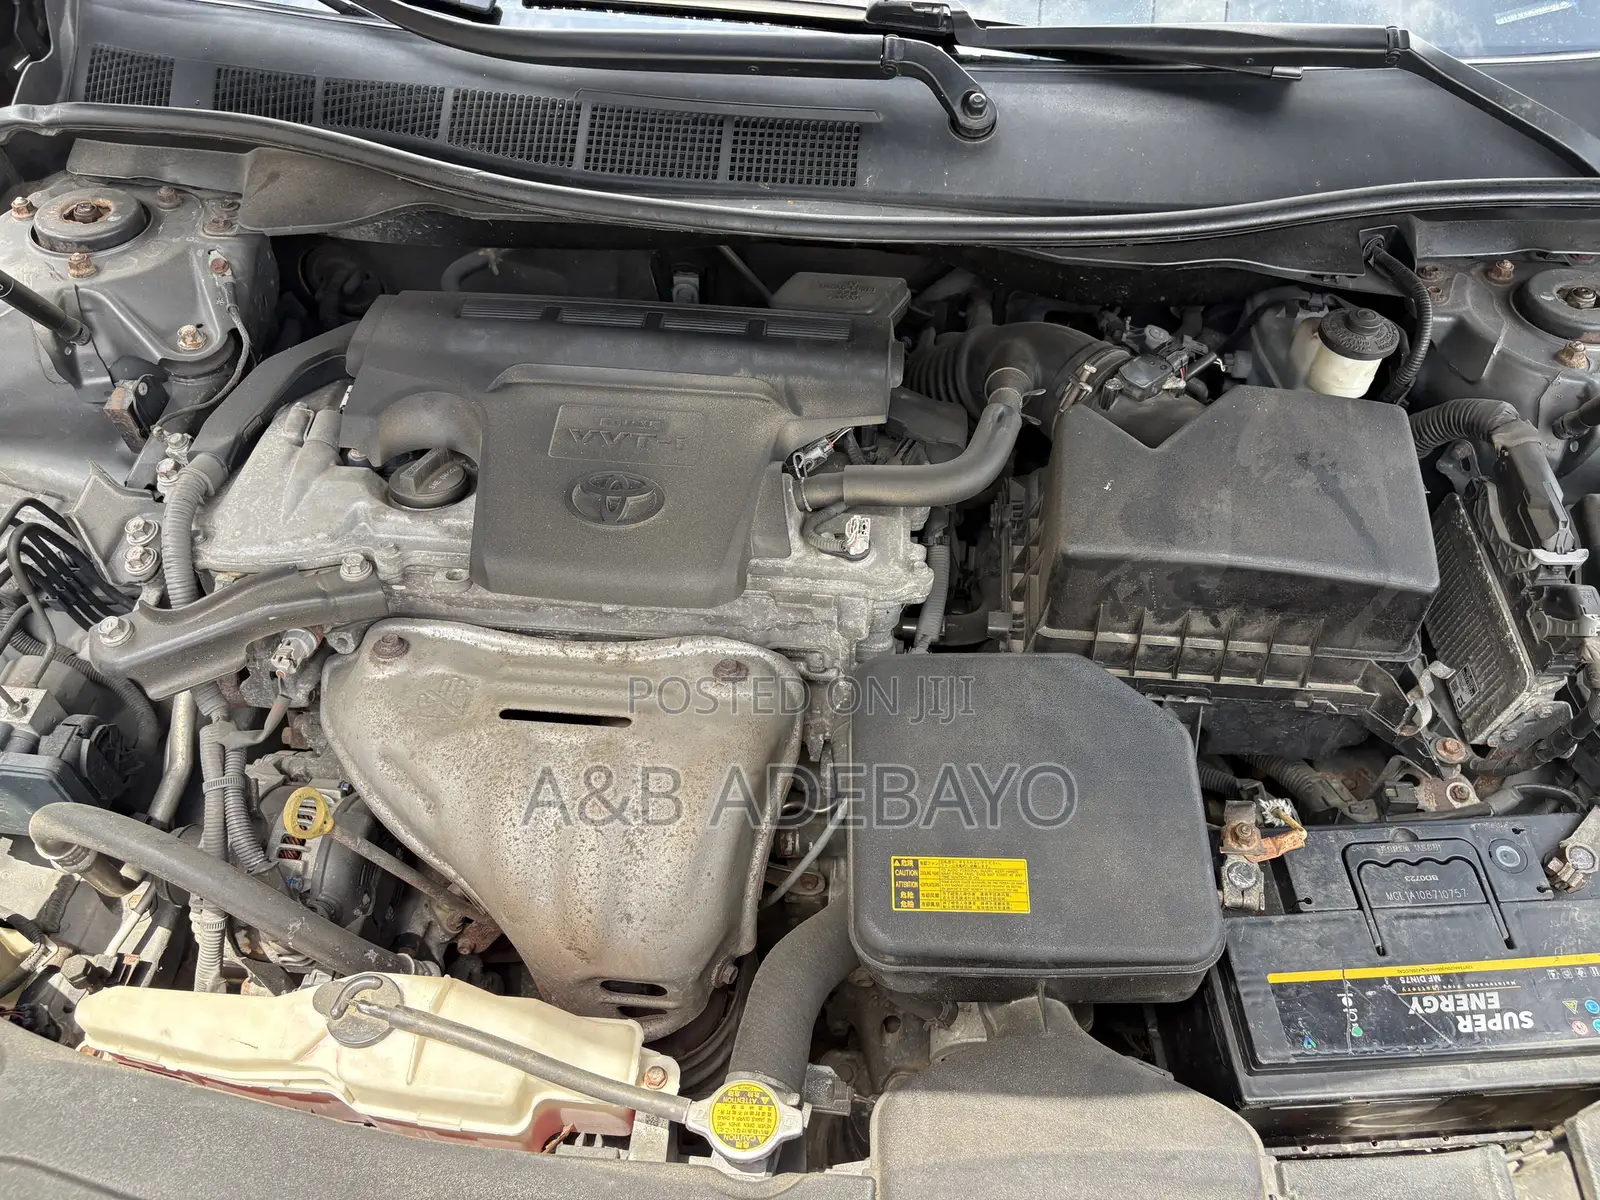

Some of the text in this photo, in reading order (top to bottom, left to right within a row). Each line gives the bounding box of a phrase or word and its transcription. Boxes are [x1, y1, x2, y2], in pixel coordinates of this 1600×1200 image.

[1399, 974, 1441, 984] MF DIN75
[1408, 991, 1501, 1015] ENERGY
[1456, 1010, 1534, 1033] SUPER
